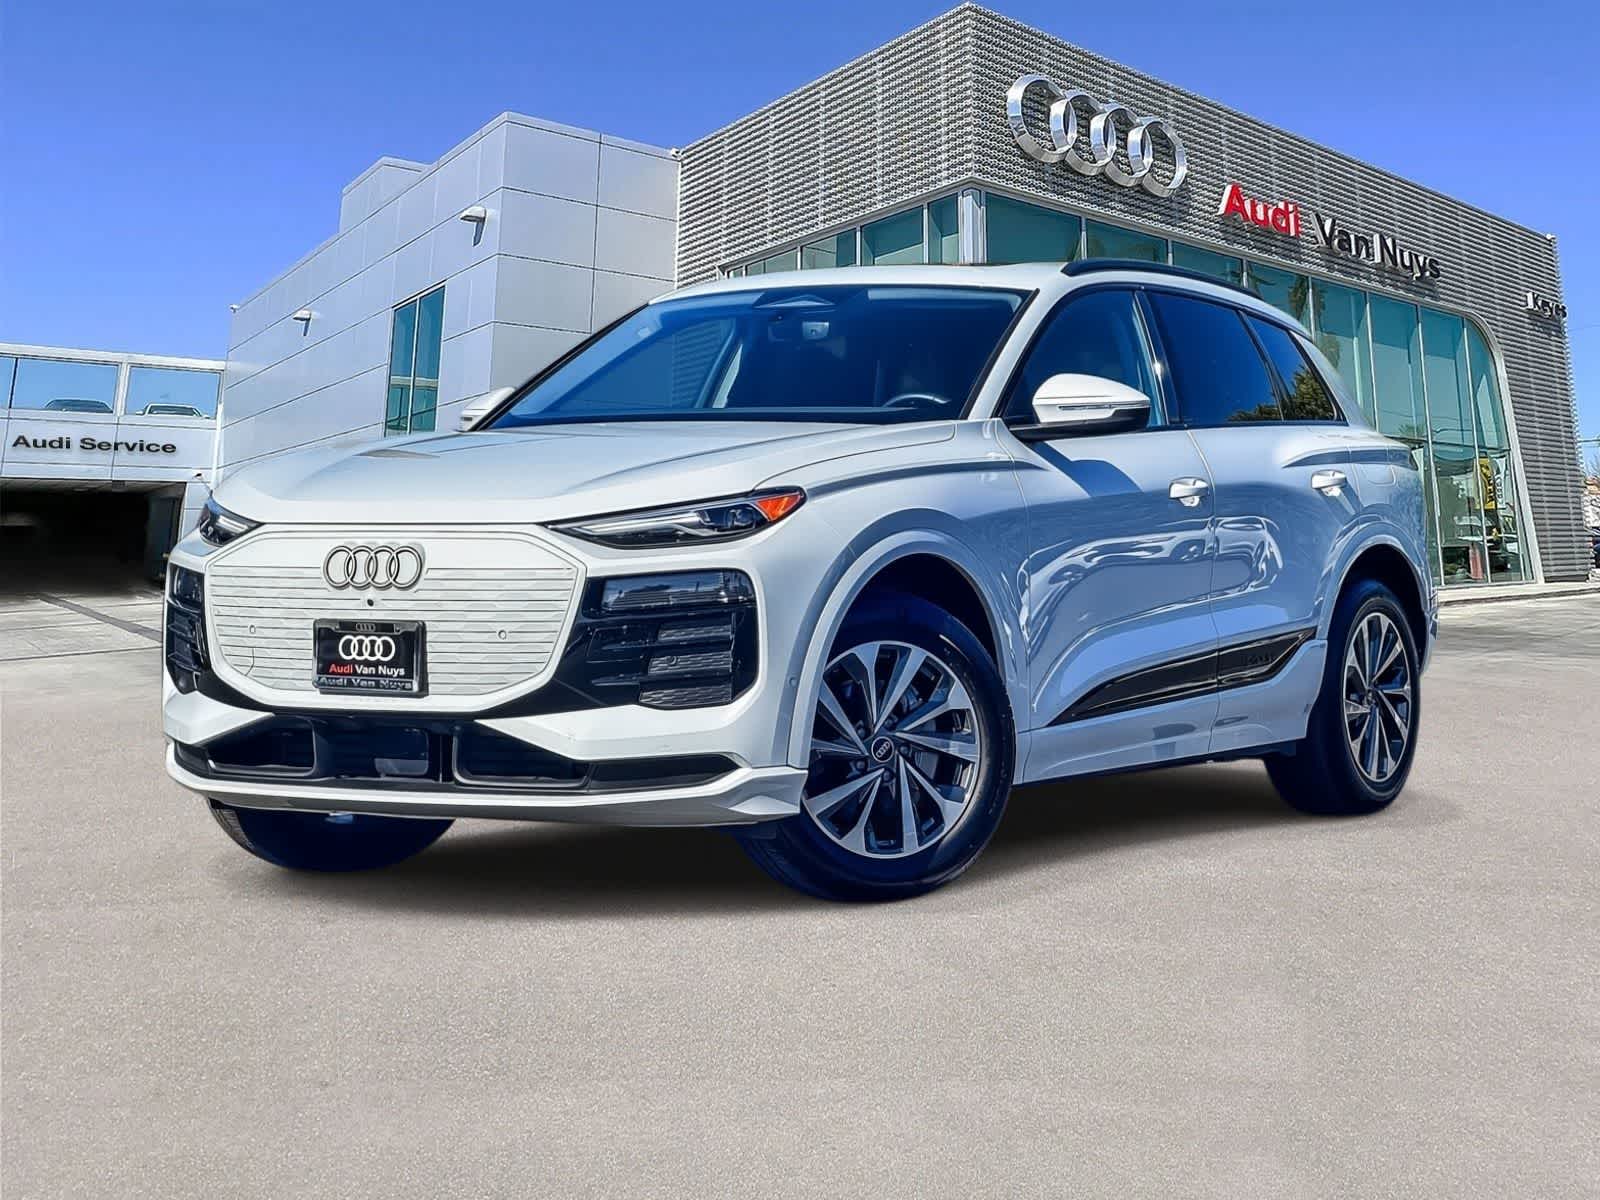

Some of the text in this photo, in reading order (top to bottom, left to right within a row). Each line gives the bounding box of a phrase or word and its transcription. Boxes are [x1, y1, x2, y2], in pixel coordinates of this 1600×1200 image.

[1217, 183, 1441, 281] Audi Van Nuys
[12, 435, 177, 454] Audi Service
[328, 663, 406, 677] Audi Van Nuys
[319, 676, 348, 687] Audi
[351, 677, 376, 688] Van
